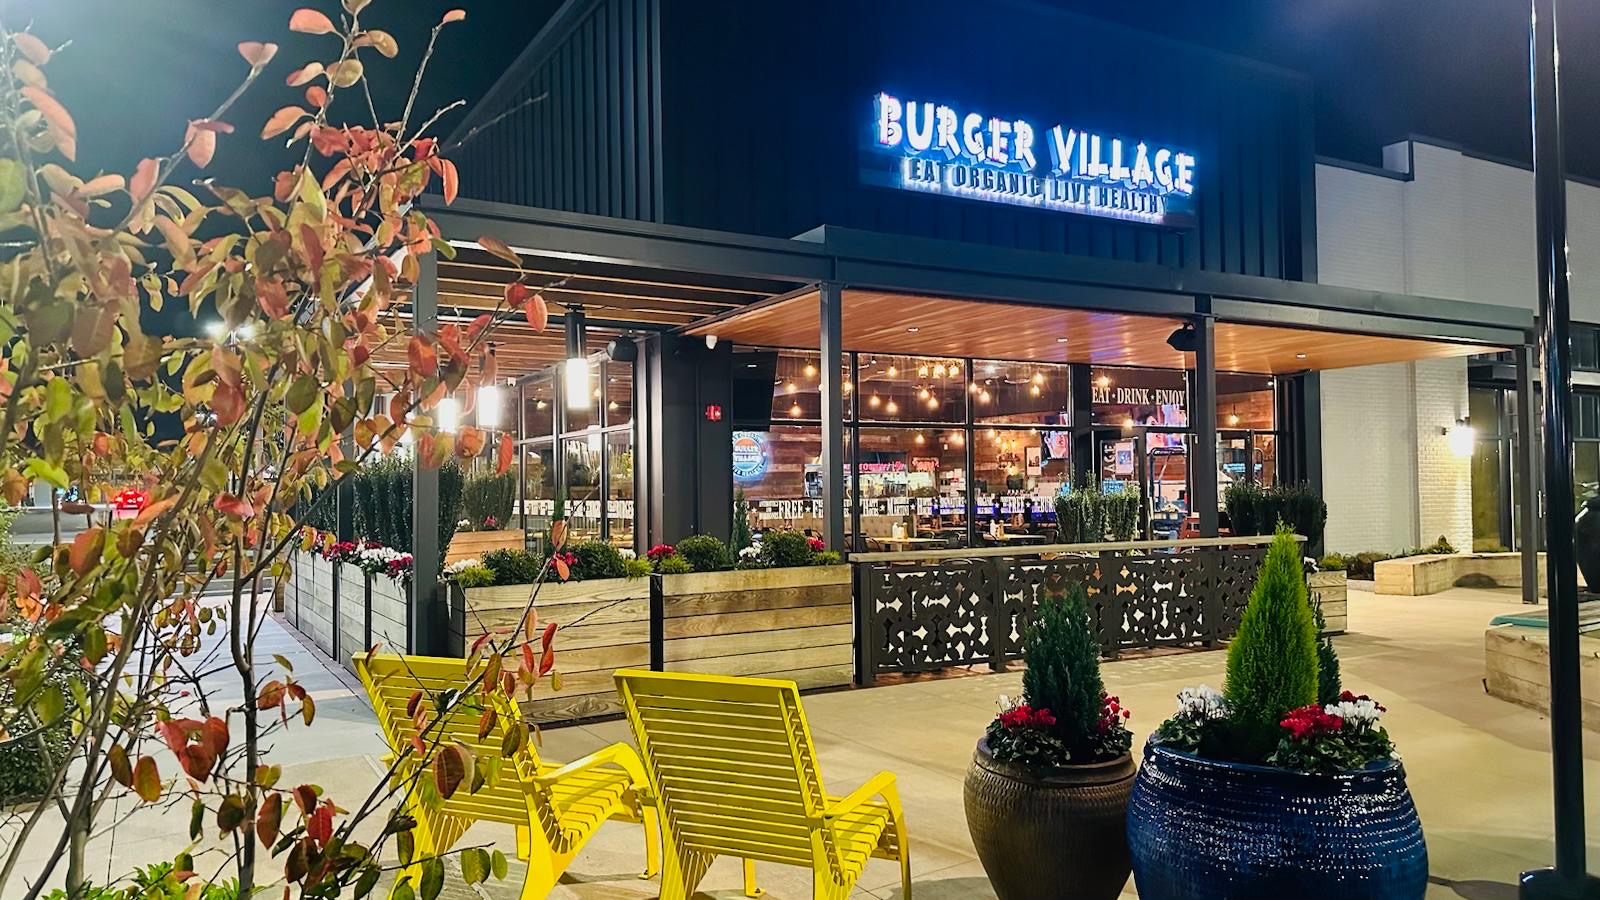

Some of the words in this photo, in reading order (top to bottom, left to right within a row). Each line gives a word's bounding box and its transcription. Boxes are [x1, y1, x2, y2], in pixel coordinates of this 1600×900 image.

[876, 91, 1037, 169] BURGER
[1050, 124, 1196, 195] VILLAGE
[907, 156, 946, 184] EAT
[1052, 178, 1091, 206] LIVE
[1097, 185, 1168, 214] HEALTHY
[1091, 387, 1111, 404] EAT
[1116, 388, 1150, 405] DRINK
[1155, 389, 1185, 406] ENJOY
[779, 499, 804, 520] FREE
